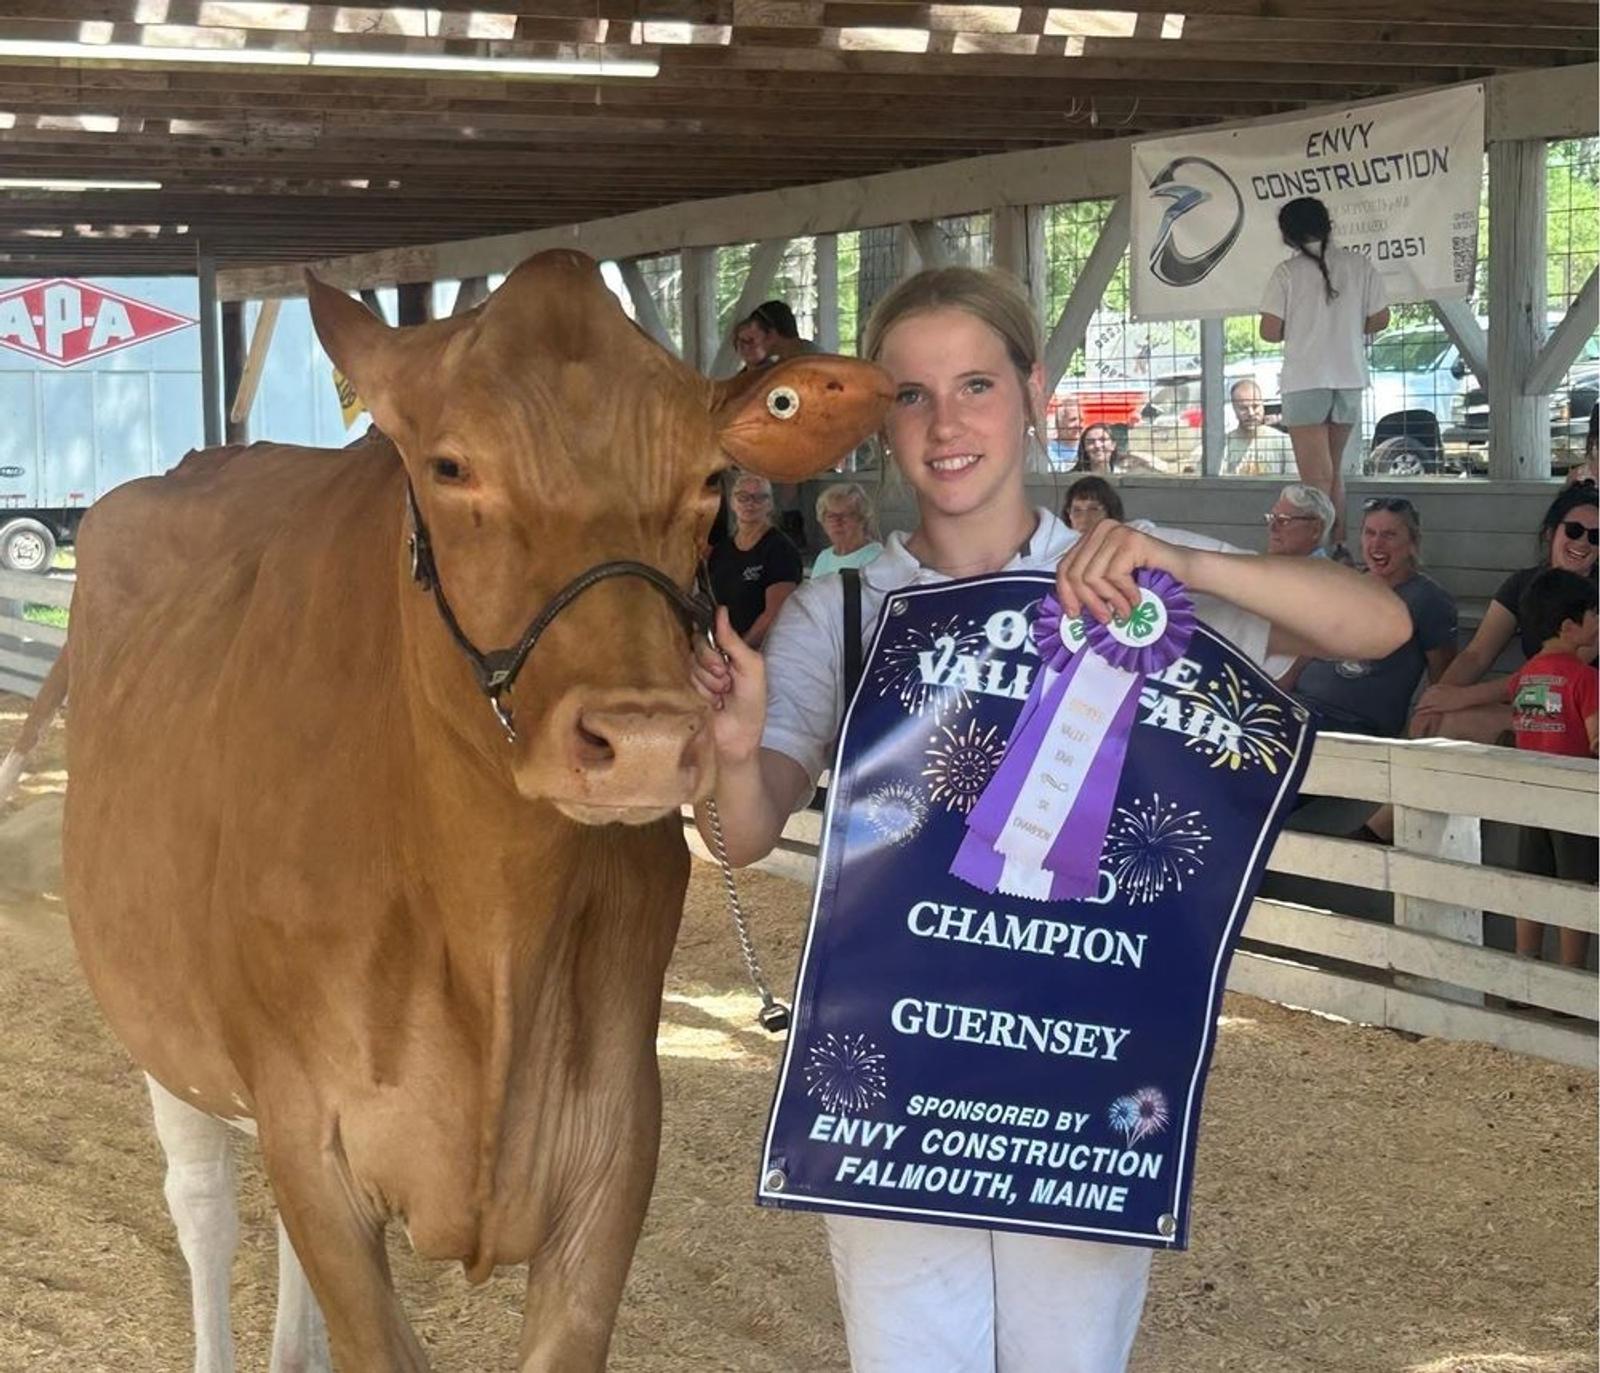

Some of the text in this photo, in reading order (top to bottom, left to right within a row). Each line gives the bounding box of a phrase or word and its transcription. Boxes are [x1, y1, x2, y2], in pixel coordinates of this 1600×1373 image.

[1306, 121, 1375, 158] ENVY
[1251, 146, 1449, 200] CONSTRUCTION
[1378, 236, 1427, 261] 0351
[906, 900, 1149, 969] CHAMPION
[891, 998, 1131, 1062] GUERNSEY
[906, 1095, 1090, 1133] SPONSORED BY
[808, 1113, 1163, 1180] ENVY CONSTRUCTION
[834, 1156, 1129, 1213] FALMOUTH, MAINE
